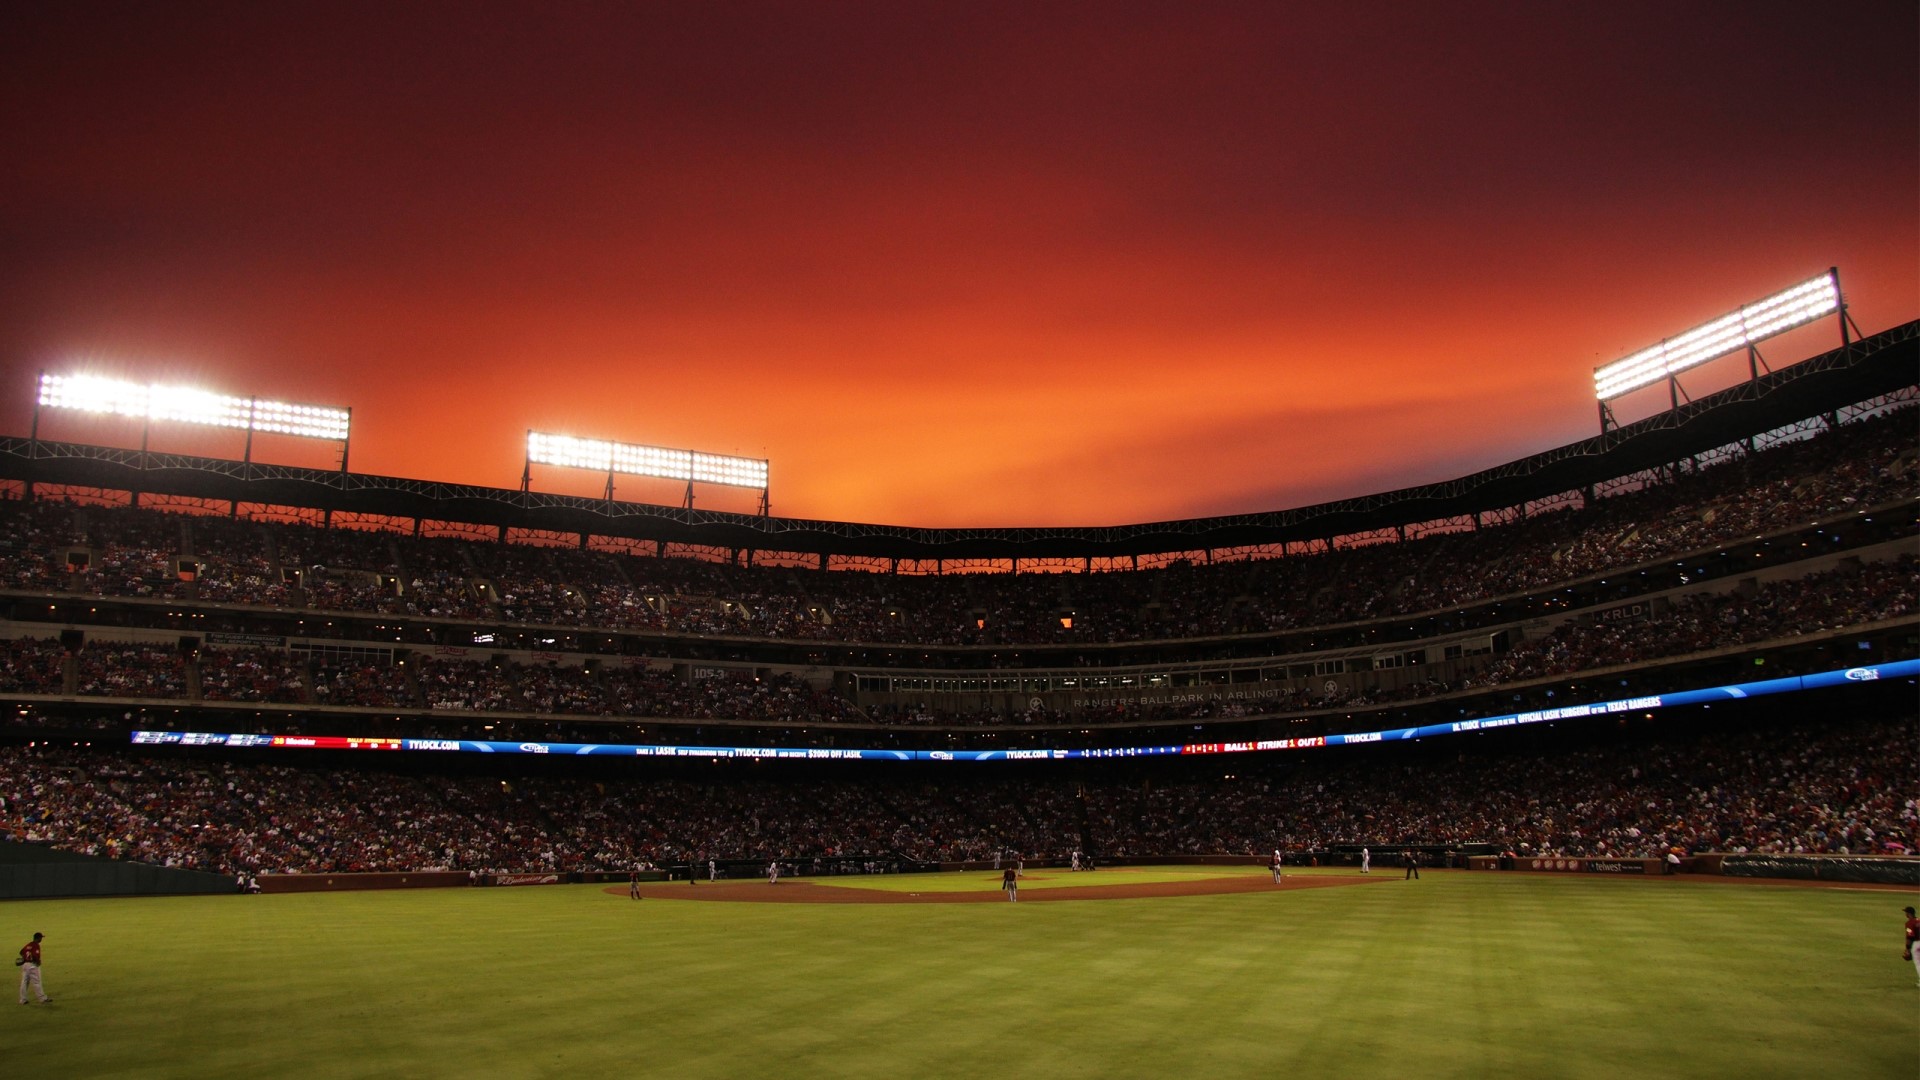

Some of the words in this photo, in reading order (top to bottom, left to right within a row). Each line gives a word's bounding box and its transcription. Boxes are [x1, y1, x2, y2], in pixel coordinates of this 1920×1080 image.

[1602, 606, 1642, 621] KRLD
[1074, 698, 1135, 708] RANGERS
[1140, 694, 1205, 705] BALLPARK
[1209, 692, 1222, 700] IN
[1227, 687, 1296, 700] ARLINGTON
[1517, 711, 1542, 724] OFFICIAL
[1542, 709, 1561, 721] LASIK
[1560, 705, 1590, 718] SURGEON
[1606, 701, 1628, 712] TEXAS
[1628, 696, 1661, 709] RANGERS
[1224, 742, 1248, 752] BALL
[1248, 742, 1254, 750] 1
[1257, 740, 1288, 750] STRIKE
[1289, 738, 1296, 748] 1
[1297, 737, 1316, 747] OUT
[1317, 736, 1324, 745] 2
[1344, 732, 1382, 744] TYLOCK.COM
[408, 740, 460, 750] TYLOCK.COM
[655, 746, 677, 755] LASIK
[735, 748, 777, 758] TYLOCK.COM
[830, 750, 843, 758] OFF
[1006, 751, 1048, 759] TYLOCK.COM
[502, 875, 542, 885] Budweiser
